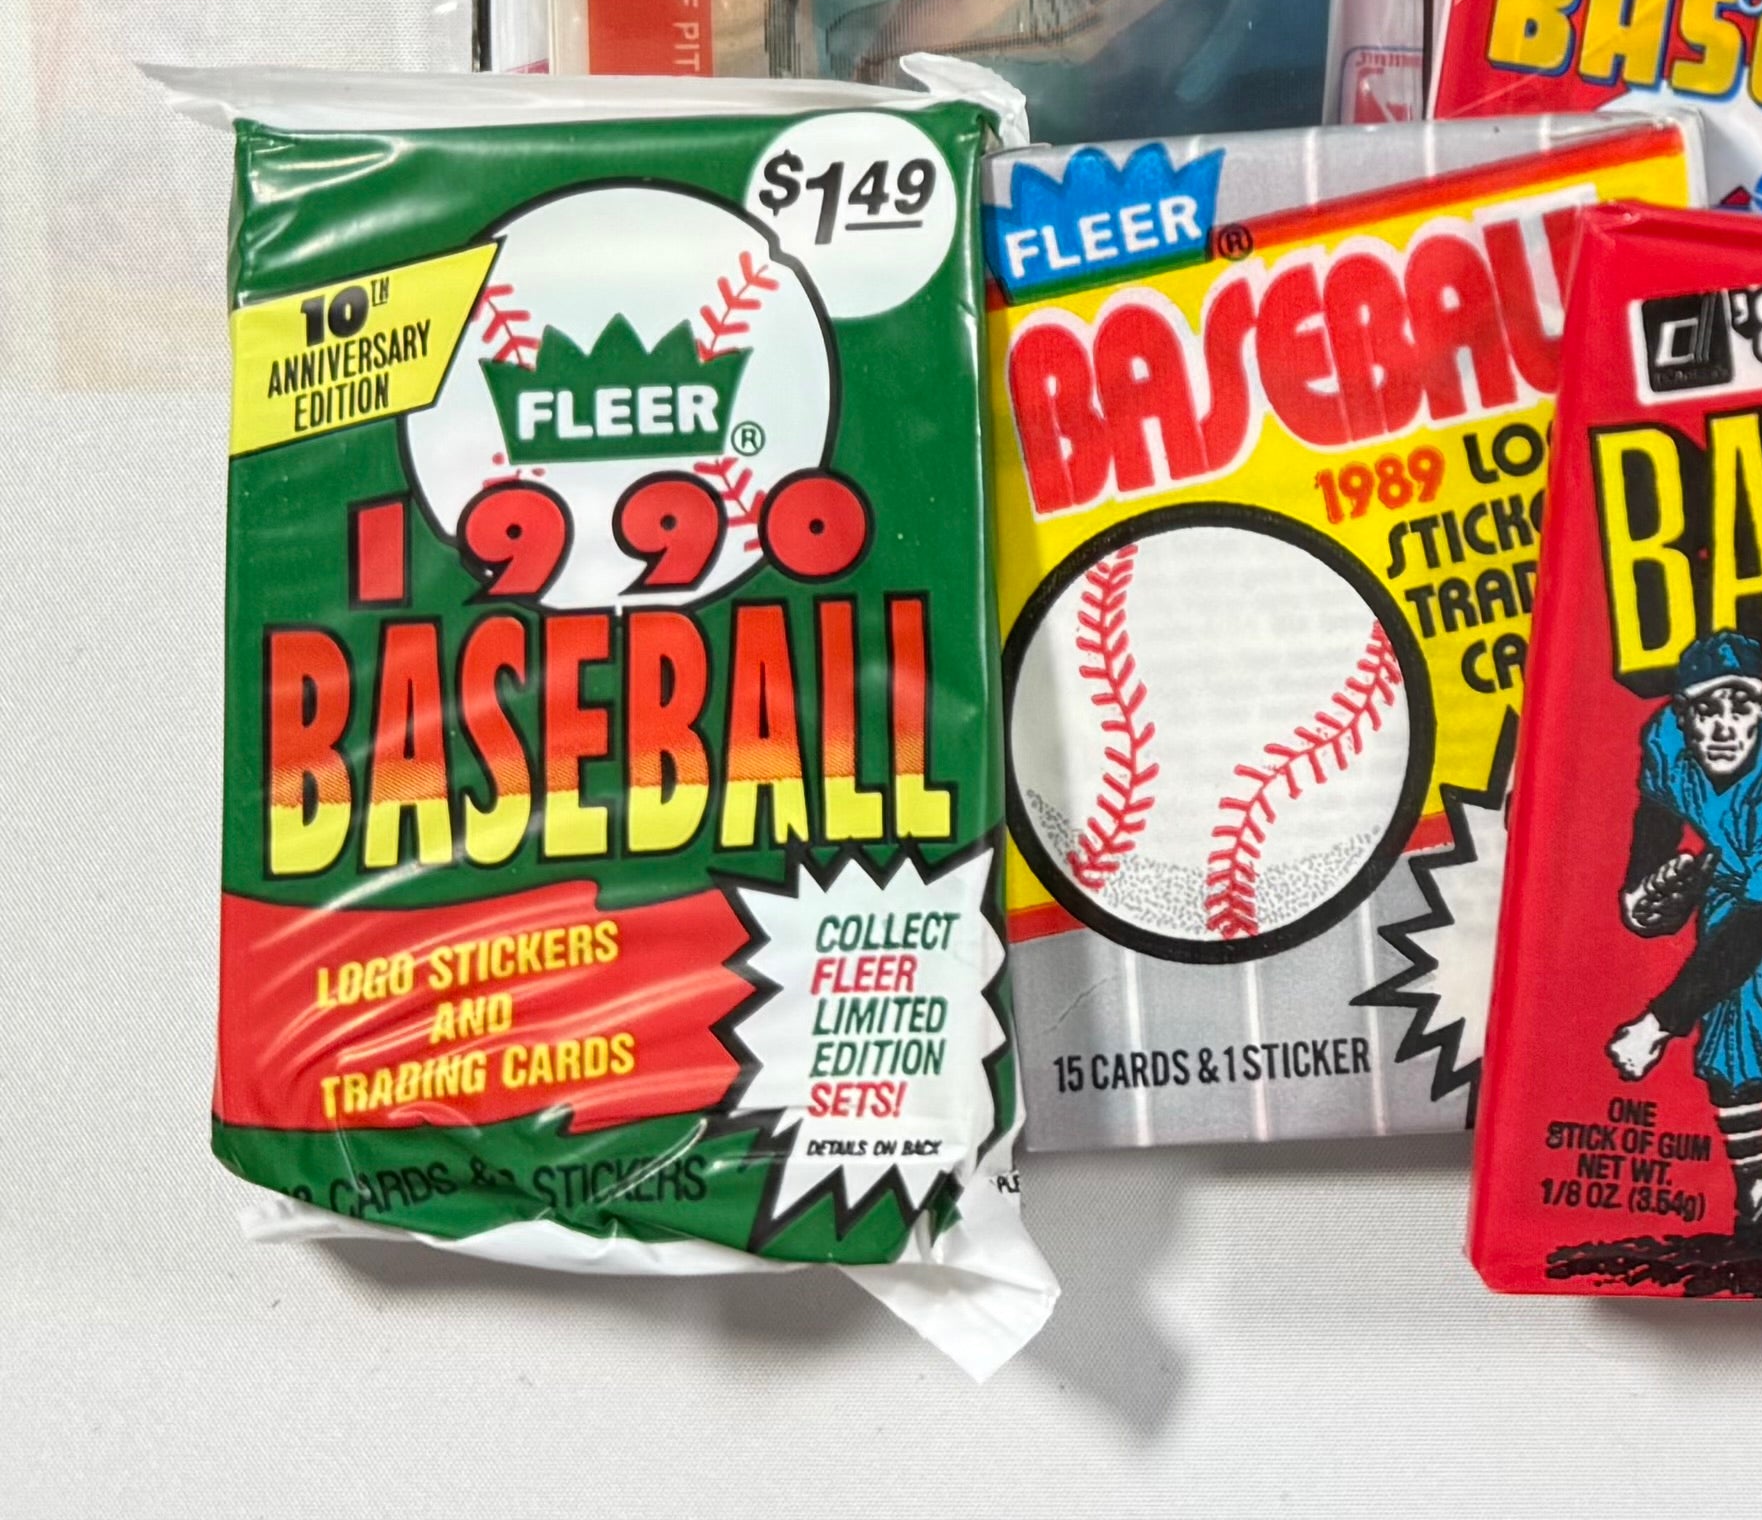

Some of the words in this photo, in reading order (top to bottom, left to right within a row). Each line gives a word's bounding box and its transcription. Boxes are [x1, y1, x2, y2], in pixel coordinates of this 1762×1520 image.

[1004, 194, 1203, 280] FLEER
[267, 320, 432, 399] ANNIVERSARY
[293, 378, 391, 433] EDITION
[516, 384, 720, 439] FLEER
[1314, 446, 1446, 524] 1989
[1463, 423, 1553, 484] LO
[348, 470, 873, 606] 1990
[1386, 488, 1546, 580] STICK
[265, 595, 953, 875] BASEBALL
[815, 911, 961, 953] COLLECT
[316, 957, 414, 1011] LOGO
[429, 920, 620, 990] STICKERS
[810, 955, 918, 996] FLEER
[430, 993, 513, 1045] AND
[812, 996, 949, 1036] LIMITED
[321, 1060, 487, 1119] TRADING
[502, 1033, 636, 1095] CARDS
[809, 1038, 947, 1078] EDITION
[1054, 1054, 1083, 1092] 15
[1091, 1049, 1190, 1089] CARDS
[1199, 1049, 1220, 1082] &
[1224, 1046, 1236, 1081] 1
[1242, 1037, 1372, 1078] STICKER
[807, 1081, 908, 1118] SETS!
[1608, 1096, 1658, 1127] ONE
[807, 1140, 868, 1156] DETAILS
[873, 1141, 898, 1156] ON
[901, 1140, 942, 1156] BACK
[1546, 1120, 1617, 1152] STICK
[1622, 1128, 1655, 1154] OF
[1658, 1132, 1712, 1162] GUM
[329, 1160, 459, 1219] CARDS
[533, 1155, 708, 1209] STICKERS
[1541, 1178, 1582, 1207] 1/8
[1586, 1181, 1623, 1209] OZ
[1577, 1153, 1626, 1180] NET
[1631, 1158, 1673, 1186] WT.
